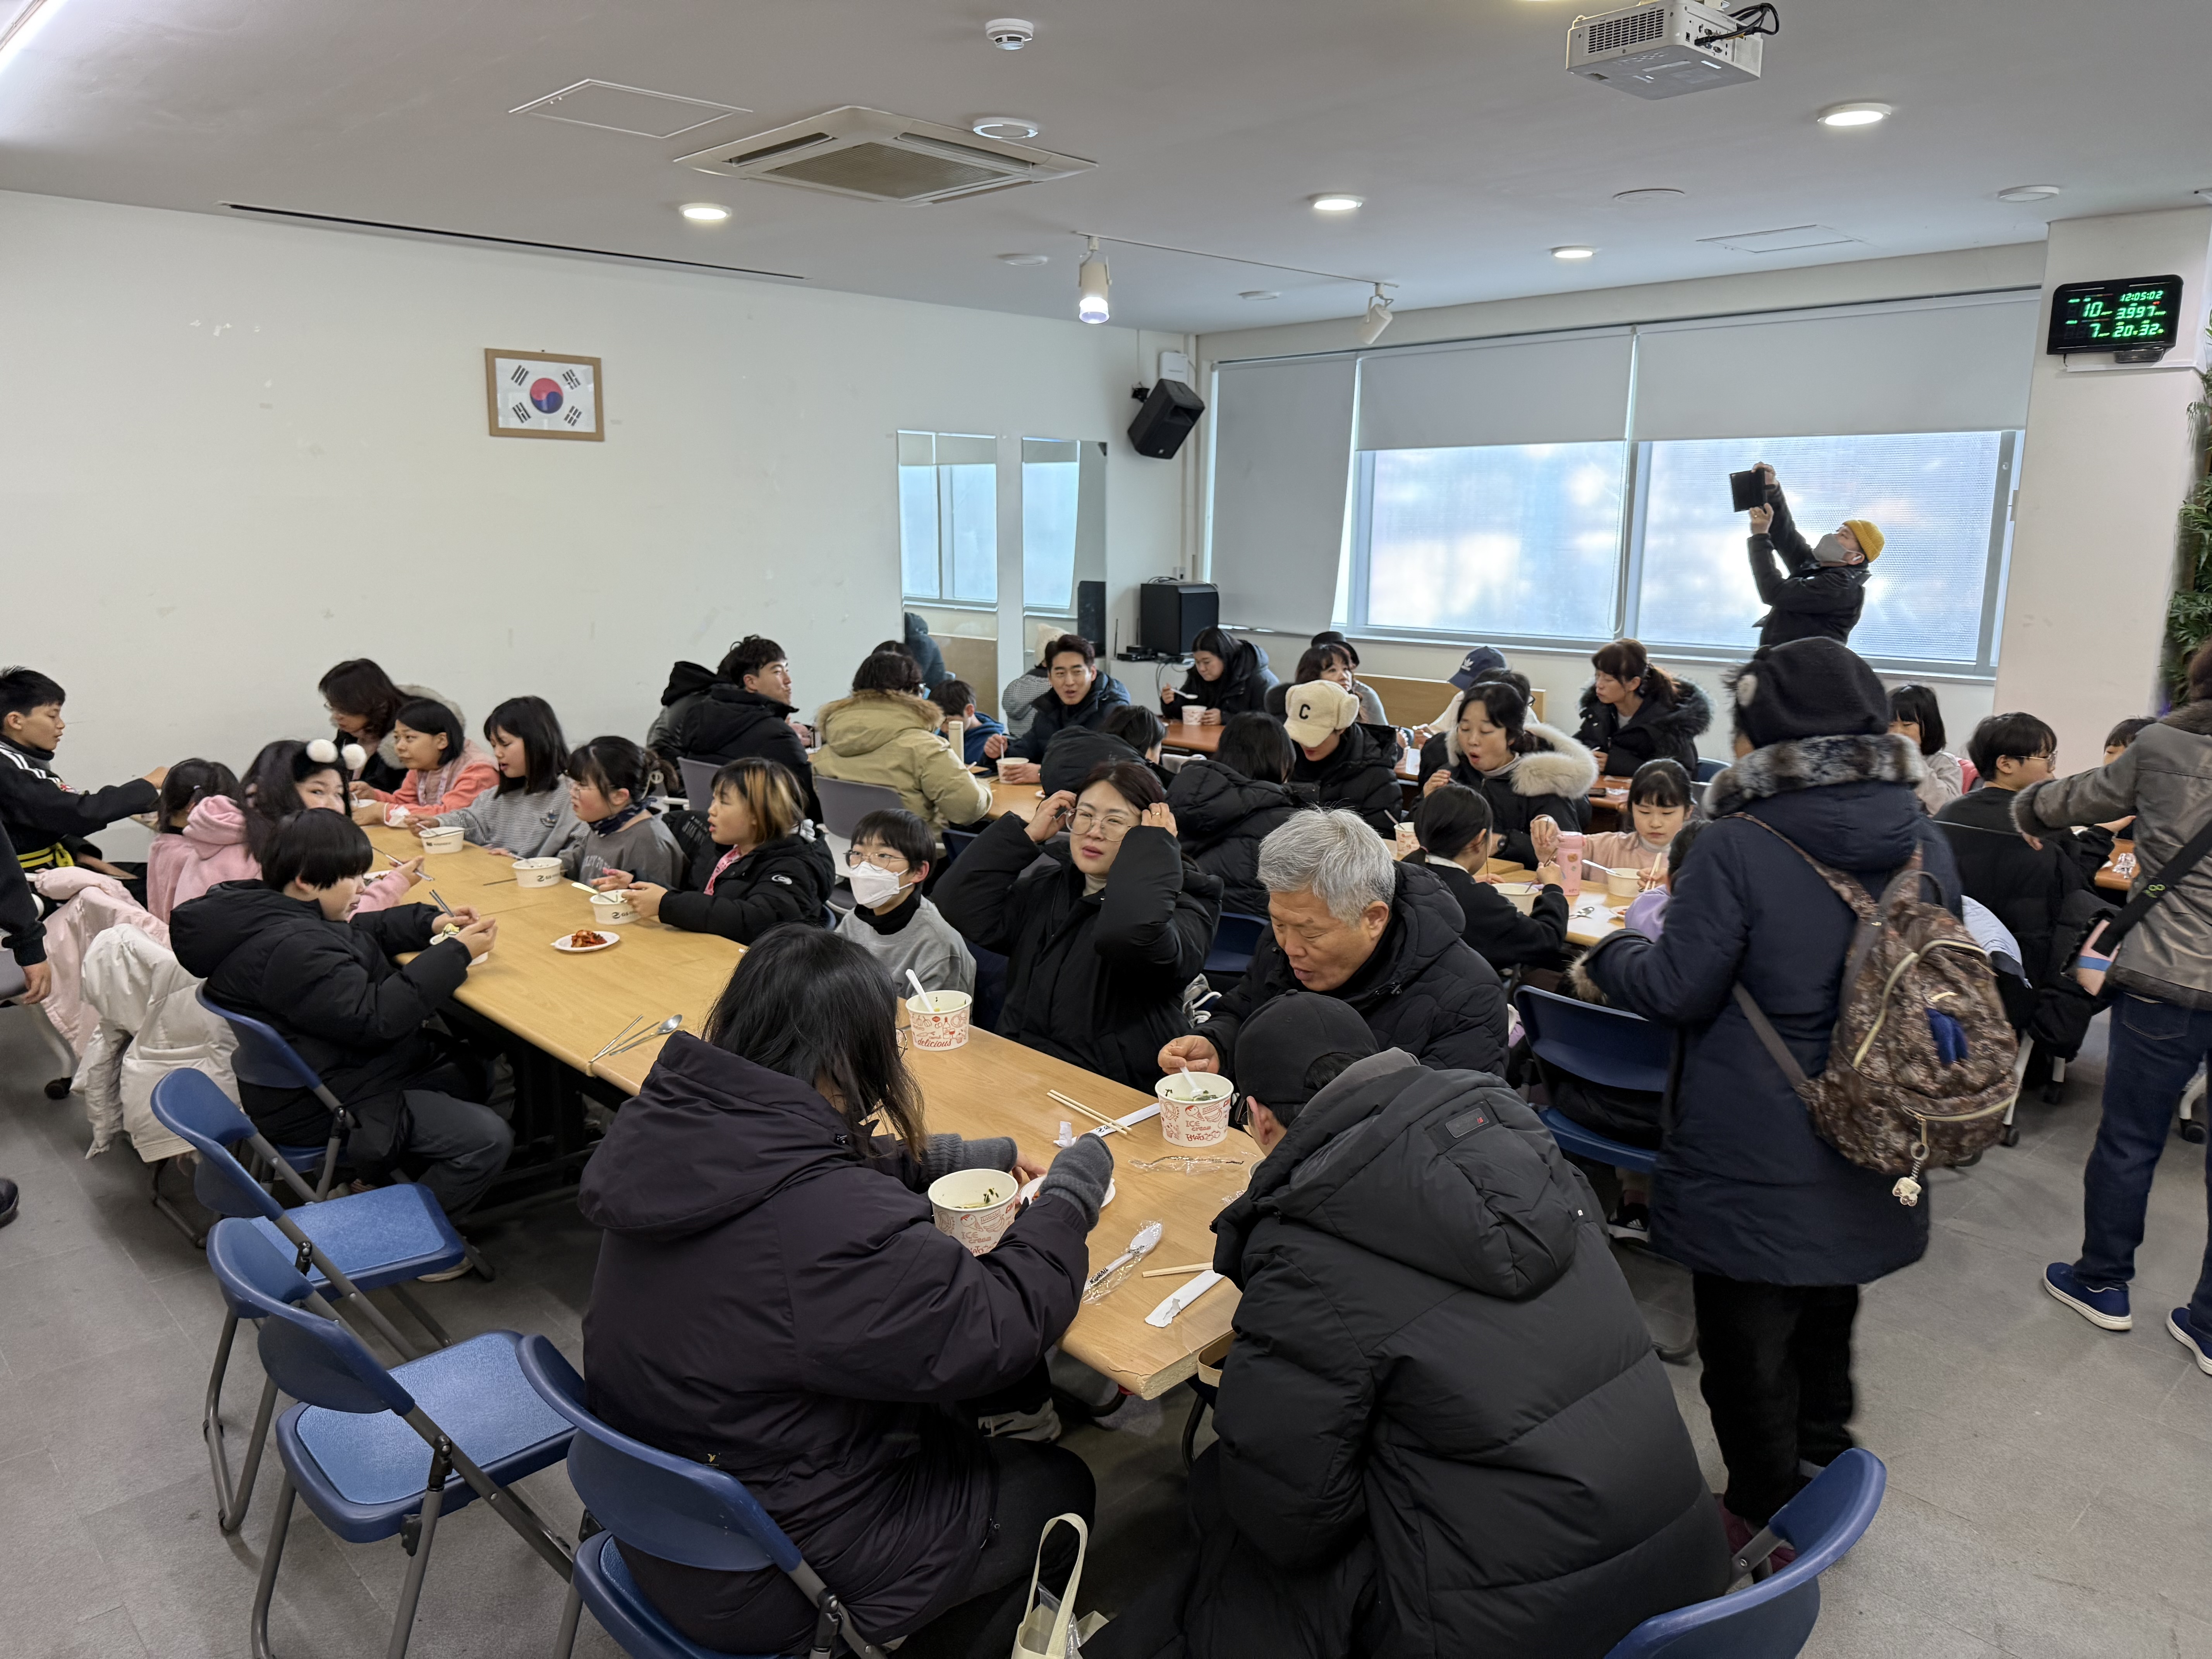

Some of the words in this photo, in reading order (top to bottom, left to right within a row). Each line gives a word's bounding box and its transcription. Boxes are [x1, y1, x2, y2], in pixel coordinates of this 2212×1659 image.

[2119, 290, 2164, 301] 12:05:02
[2083, 301, 2104, 317] 10
[2090, 323, 2102, 338] 7
[1299, 704, 1311, 720] C
[917, 1038, 952, 1048] delicious
[1089, 1267, 1109, 1284] KORAIL
